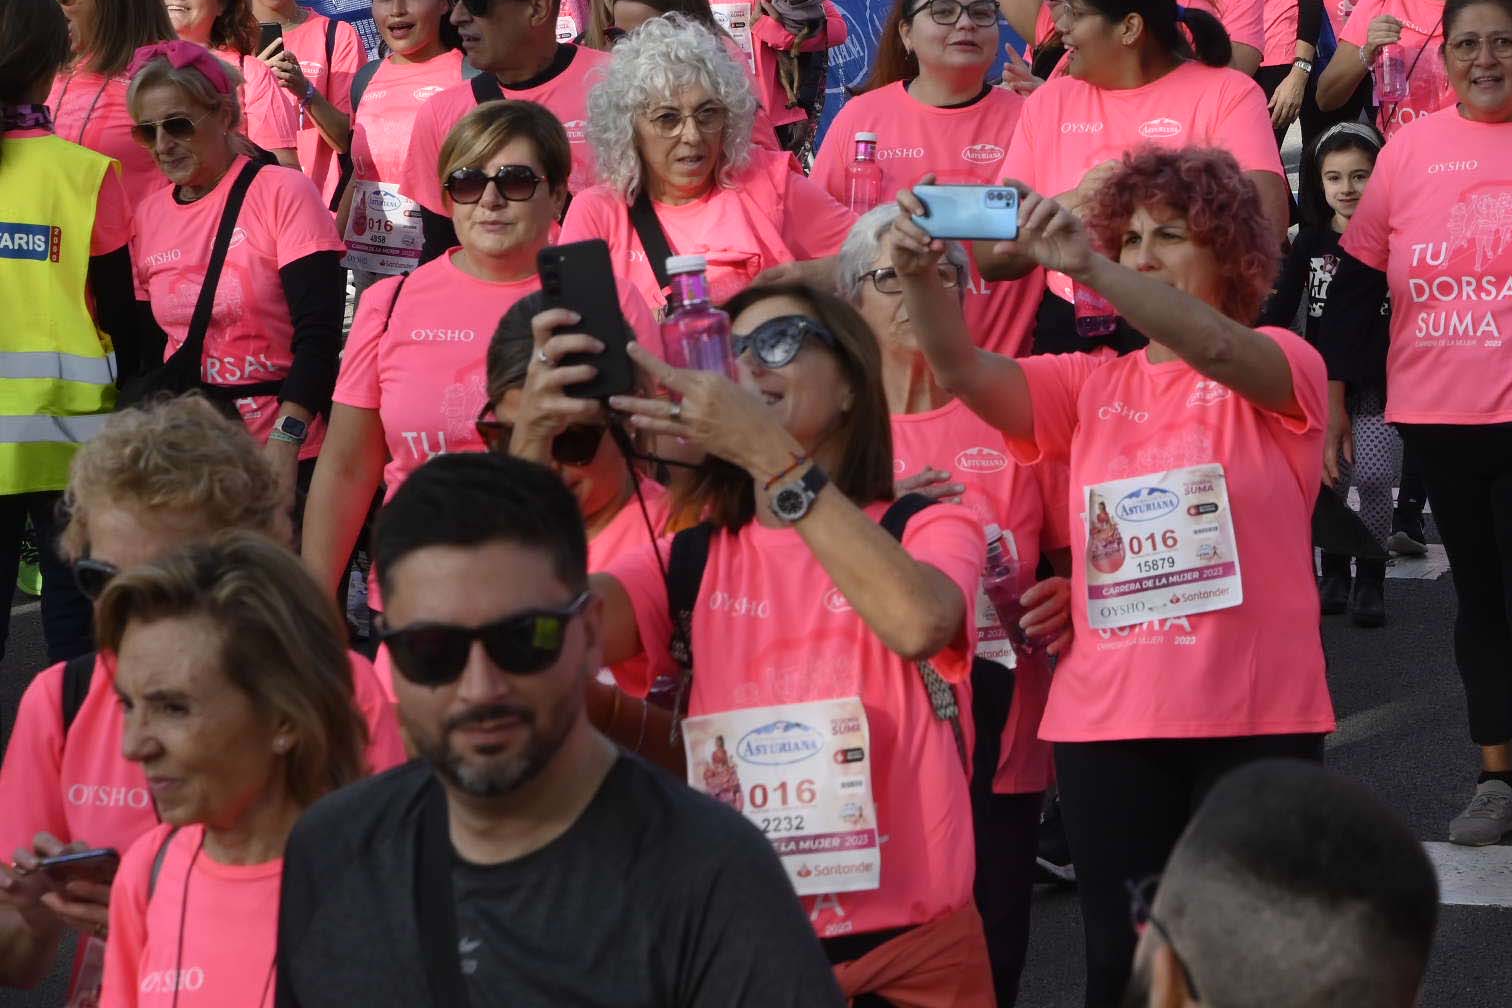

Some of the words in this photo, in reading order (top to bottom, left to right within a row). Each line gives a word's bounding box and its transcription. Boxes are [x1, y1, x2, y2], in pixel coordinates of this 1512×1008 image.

[1060, 121, 1104, 136] OYSHO
[877, 146, 924, 162] OYSHO
[1428, 159, 1479, 176] OYSHO
[368, 217, 394, 233] 016
[145, 249, 181, 267] OYSHO
[1410, 242, 1448, 267] TU
[1415, 311, 1500, 338] SUMA
[411, 328, 475, 343] OYSHO
[401, 430, 448, 460] TU
[960, 457, 1004, 468] ASTURIANA
[1184, 484, 1215, 496] SUMA
[1120, 498, 1176, 518] ASTURIANA
[1129, 529, 1179, 556] 016
[1136, 556, 1176, 574] 15879
[1102, 582, 1141, 596] CARRERA
[1143, 578, 1153, 589] DE
[1155, 576, 1167, 587] LA
[1168, 572, 1200, 584] MUJER
[1203, 568, 1224, 578] 2023
[1100, 601, 1146, 619] OYSHO
[1182, 587, 1231, 604] Santander
[976, 647, 1012, 660] antander
[831, 722, 862, 737] SUMA
[742, 738, 819, 758] ASTURIANA
[68, 783, 150, 809] OYSHO
[749, 778, 817, 809] 016
[762, 815, 806, 834] 2232
[781, 840, 798, 853] LA
[800, 837, 842, 851] MUJER
[845, 834, 869, 846] 2023
[814, 860, 874, 876] Santander
